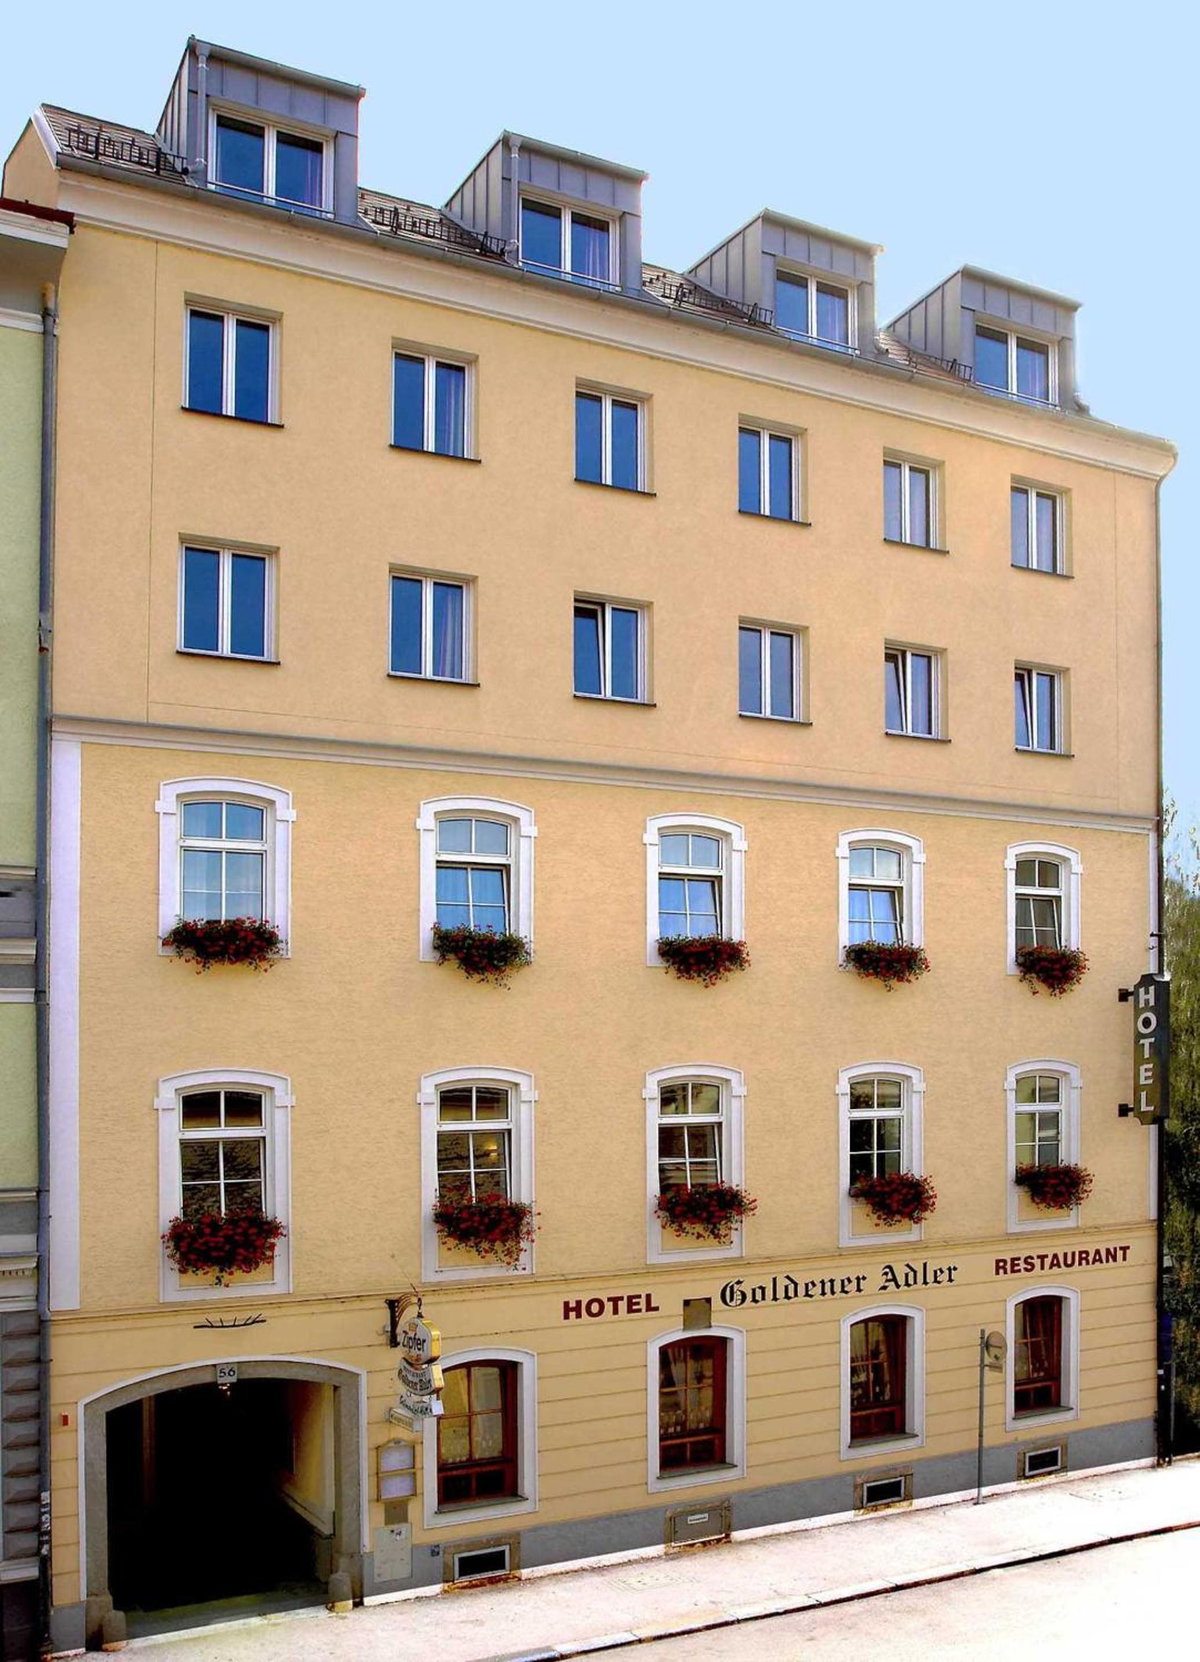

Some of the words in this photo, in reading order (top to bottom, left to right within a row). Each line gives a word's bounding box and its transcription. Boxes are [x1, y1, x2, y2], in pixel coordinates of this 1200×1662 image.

[1137, 985, 1157, 1112] HOTEL
[994, 1245, 1130, 1276] RESTAURANT
[720, 1274, 867, 1308] Goldener
[877, 1262, 958, 1291] Adler
[562, 1293, 660, 1321] HOTEL
[401, 1330, 427, 1353] Zipfer
[218, 1366, 236, 1379] 56
